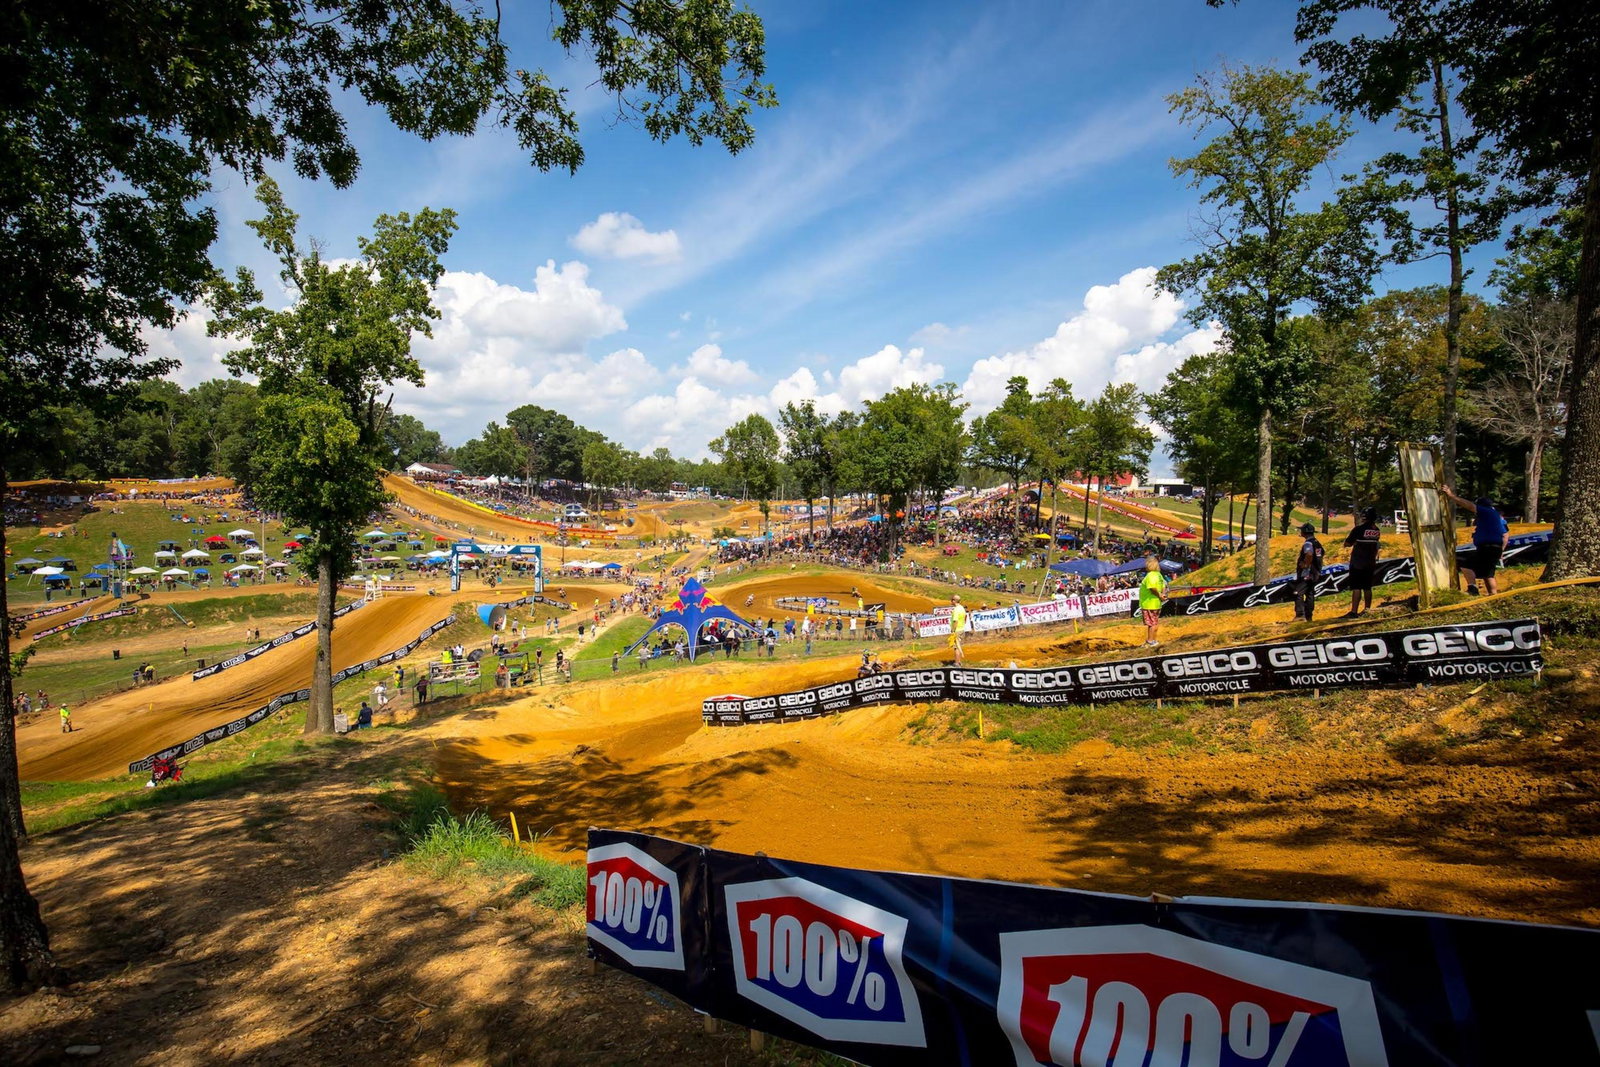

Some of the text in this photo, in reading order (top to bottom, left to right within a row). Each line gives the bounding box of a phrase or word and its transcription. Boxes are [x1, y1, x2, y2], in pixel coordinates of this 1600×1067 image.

[1021, 601, 1058, 616] ROCZEN
[1268, 638, 1388, 668] GEICO
[1162, 651, 1258, 678] GEICO
[1428, 660, 1542, 677] MOTORCYCLE
[896, 671, 945, 687] GEICO
[949, 670, 1005, 688] GEICO
[1011, 670, 1073, 688] GEICO
[1078, 662, 1154, 685] GEICO
[1289, 670, 1379, 686] MOTORCYCLE
[818, 682, 852, 700] GEICO
[854, 674, 893, 692] GEICO
[1179, 679, 1250, 694] MOTORCYCLE
[779, 692, 816, 707] GEICO
[862, 692, 890, 703] MOTORCYCLE
[905, 690, 941, 699] MOTORCYCLE
[958, 690, 1000, 701] MOTORCYCLE
[1019, 693, 1068, 704] MOTORCYCLE
[1091, 687, 1149, 700] MOTORCYCLE
[716, 702, 741, 712] GEICO
[743, 697, 777, 711] GEICO
[823, 699, 850, 710] MOTORCYCLE
[590, 870, 668, 945] 100%
[749, 911, 887, 1012] 100%
